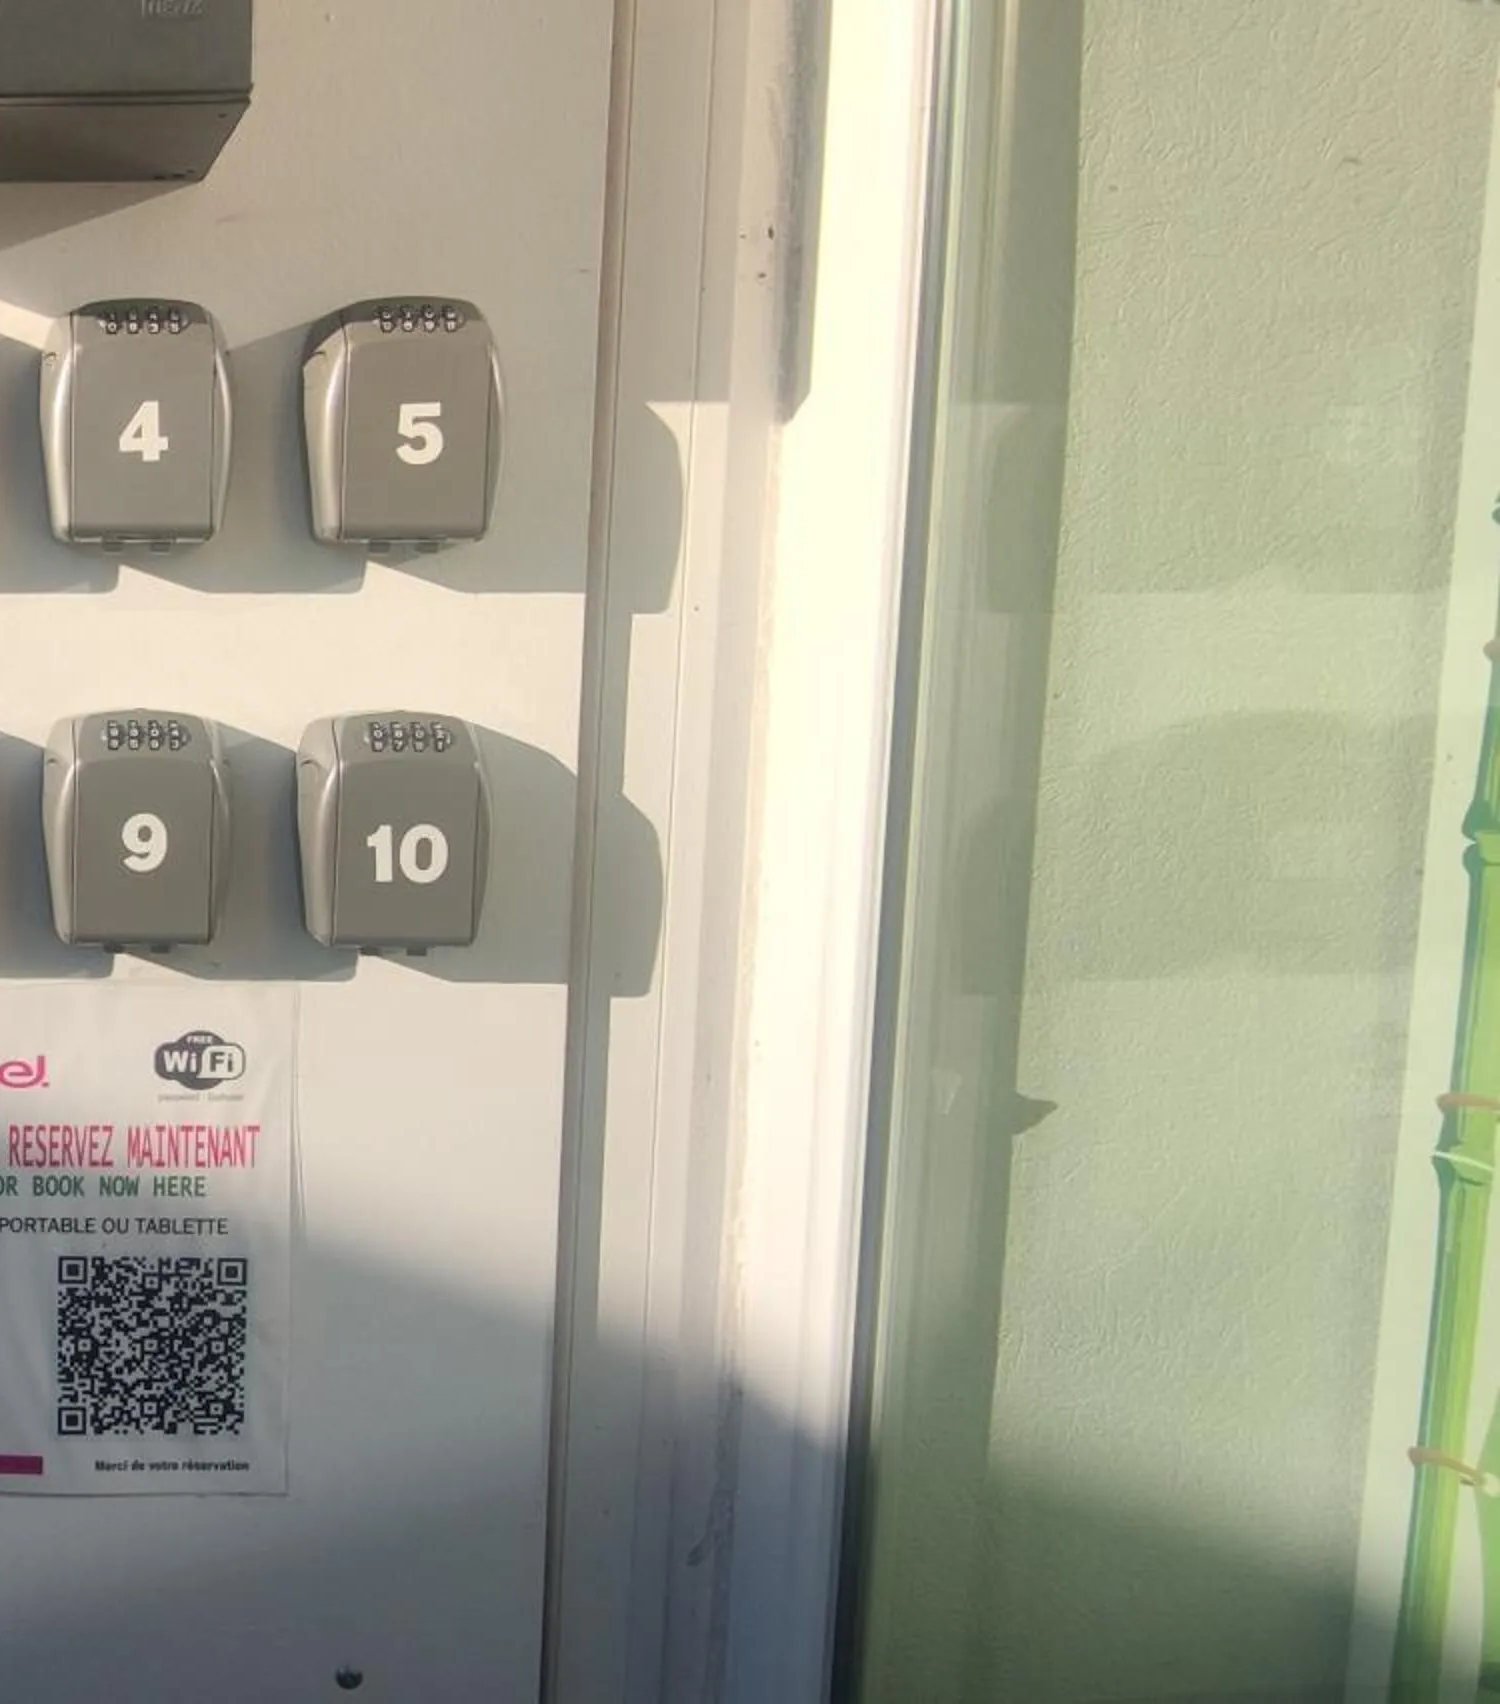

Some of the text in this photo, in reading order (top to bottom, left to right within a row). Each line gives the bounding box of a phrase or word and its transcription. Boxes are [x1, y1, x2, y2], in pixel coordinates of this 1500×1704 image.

[119, 401, 169, 462] 4
[396, 402, 444, 465] 5
[121, 813, 168, 872] 9
[367, 824, 448, 884] 10
[9, 1125, 114, 1168] RESERVEZ
[127, 1125, 260, 1168] MAINTENANT
[33, 1175, 84, 1197] BOOK
[100, 1175, 140, 1197] NOW
[153, 1175, 207, 1197] HERE
[102, 1217, 129, 1234] OU
[136, 1217, 229, 1235] TABLETTE
[95, 1460, 128, 1471] Merci
[131, 1460, 145, 1471] de
[149, 1461, 179, 1471] votre
